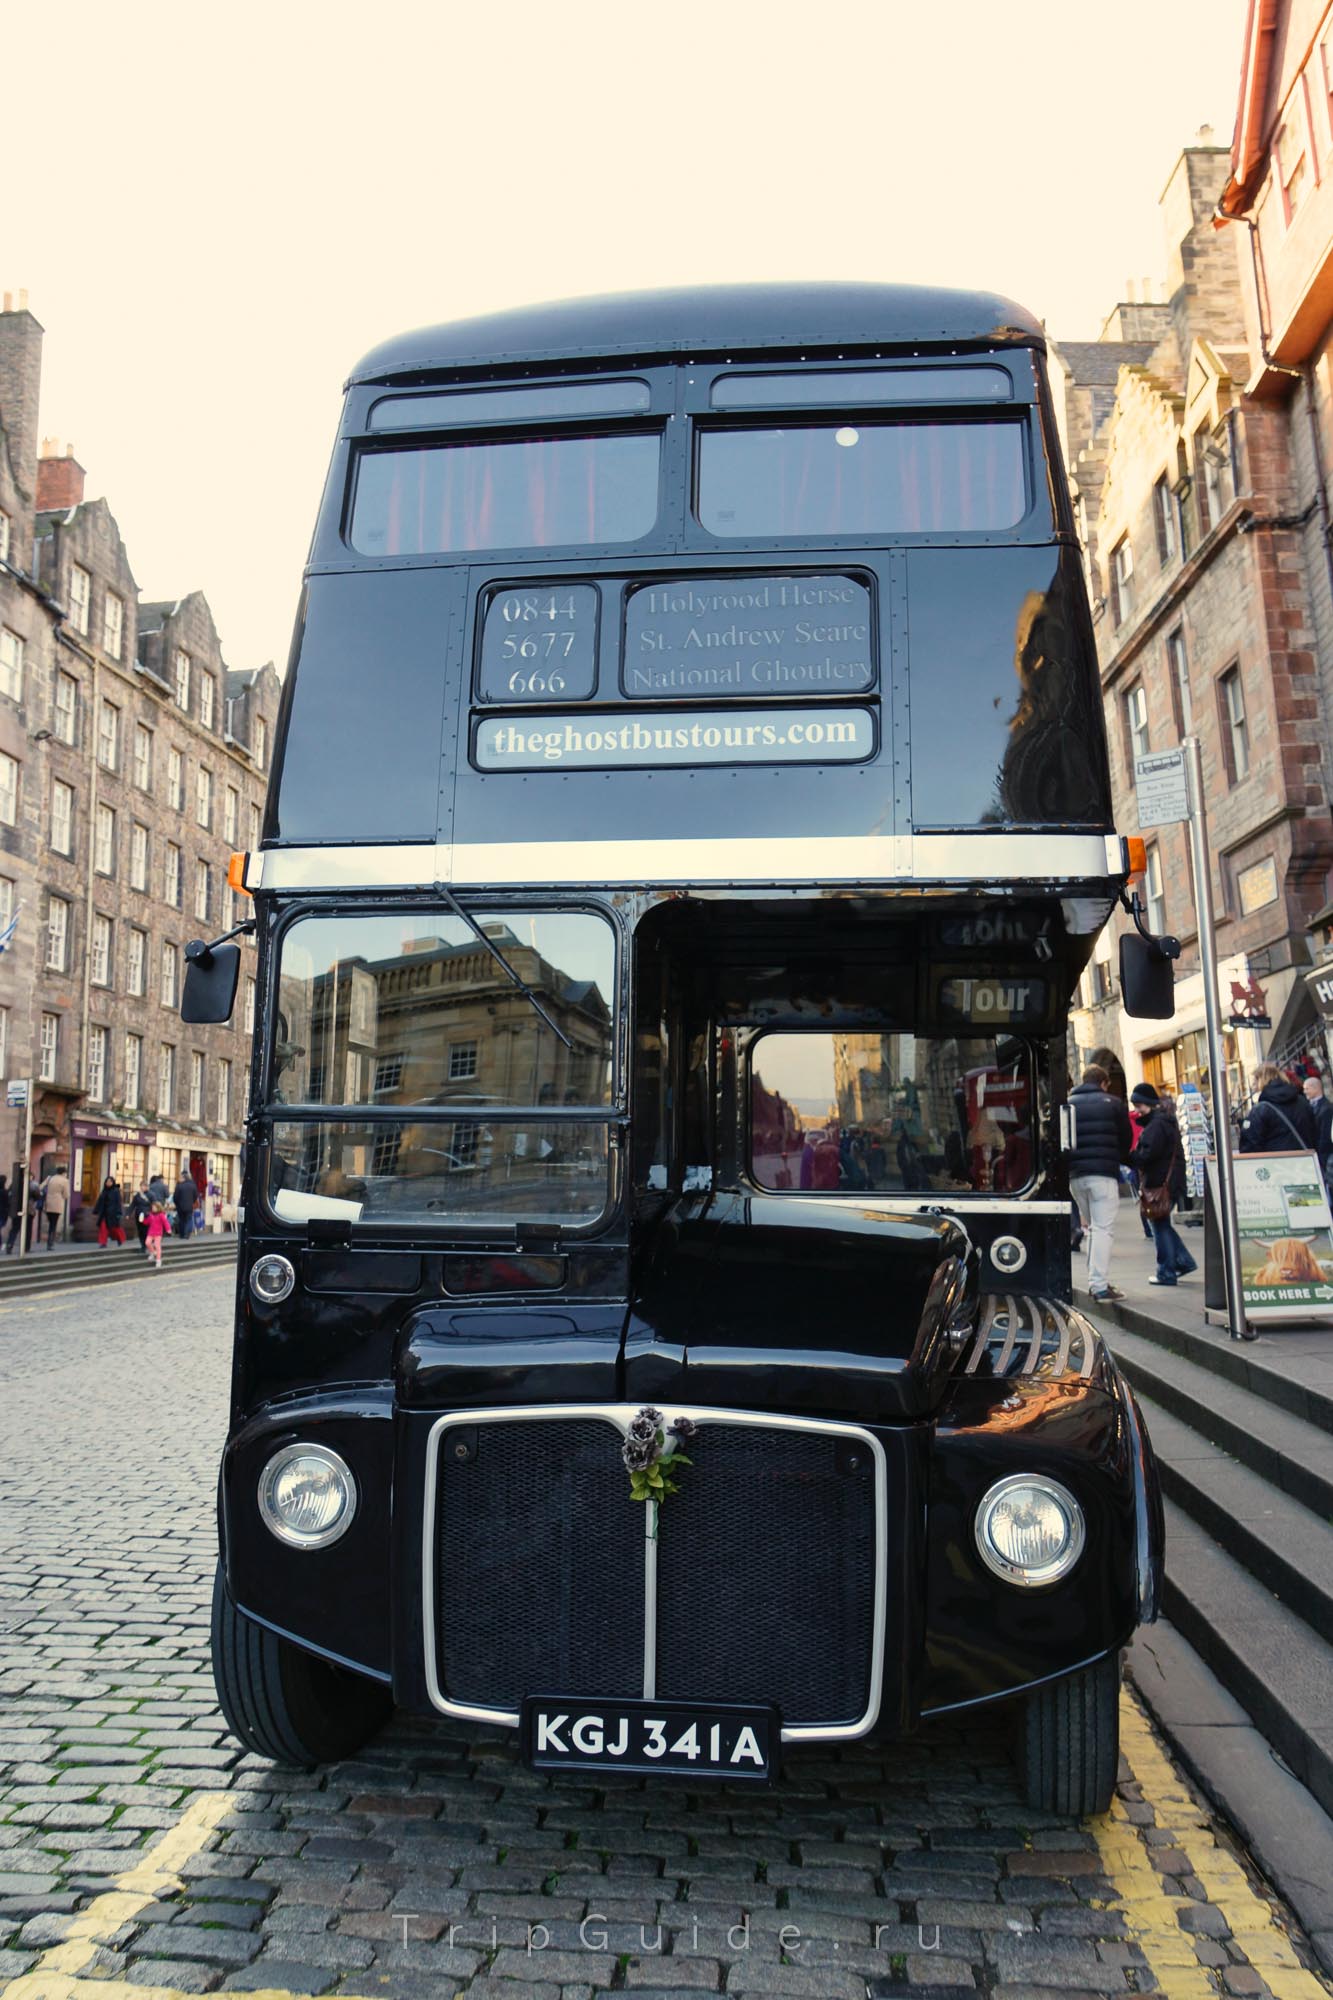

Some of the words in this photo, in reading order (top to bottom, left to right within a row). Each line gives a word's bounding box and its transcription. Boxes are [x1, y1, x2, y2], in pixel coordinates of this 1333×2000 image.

[503, 595, 576, 622] 0844
[648, 586, 769, 617] Holyrood
[502, 632, 576, 659] 5677
[640, 630, 672, 652] St.
[683, 625, 786, 649] Andrew
[508, 665, 567, 694] 666
[631, 661, 741, 690] National
[751, 657, 873, 684] Ghoulery
[493, 719, 857, 760] theghostbustours.com
[953, 979, 1030, 1013] Tour
[1243, 1290, 1277, 1301] BOOK
[1278, 1288, 1311, 1300] HERE
[537, 1713, 629, 1756] KGJ
[642, 1719, 765, 1766] 341A
